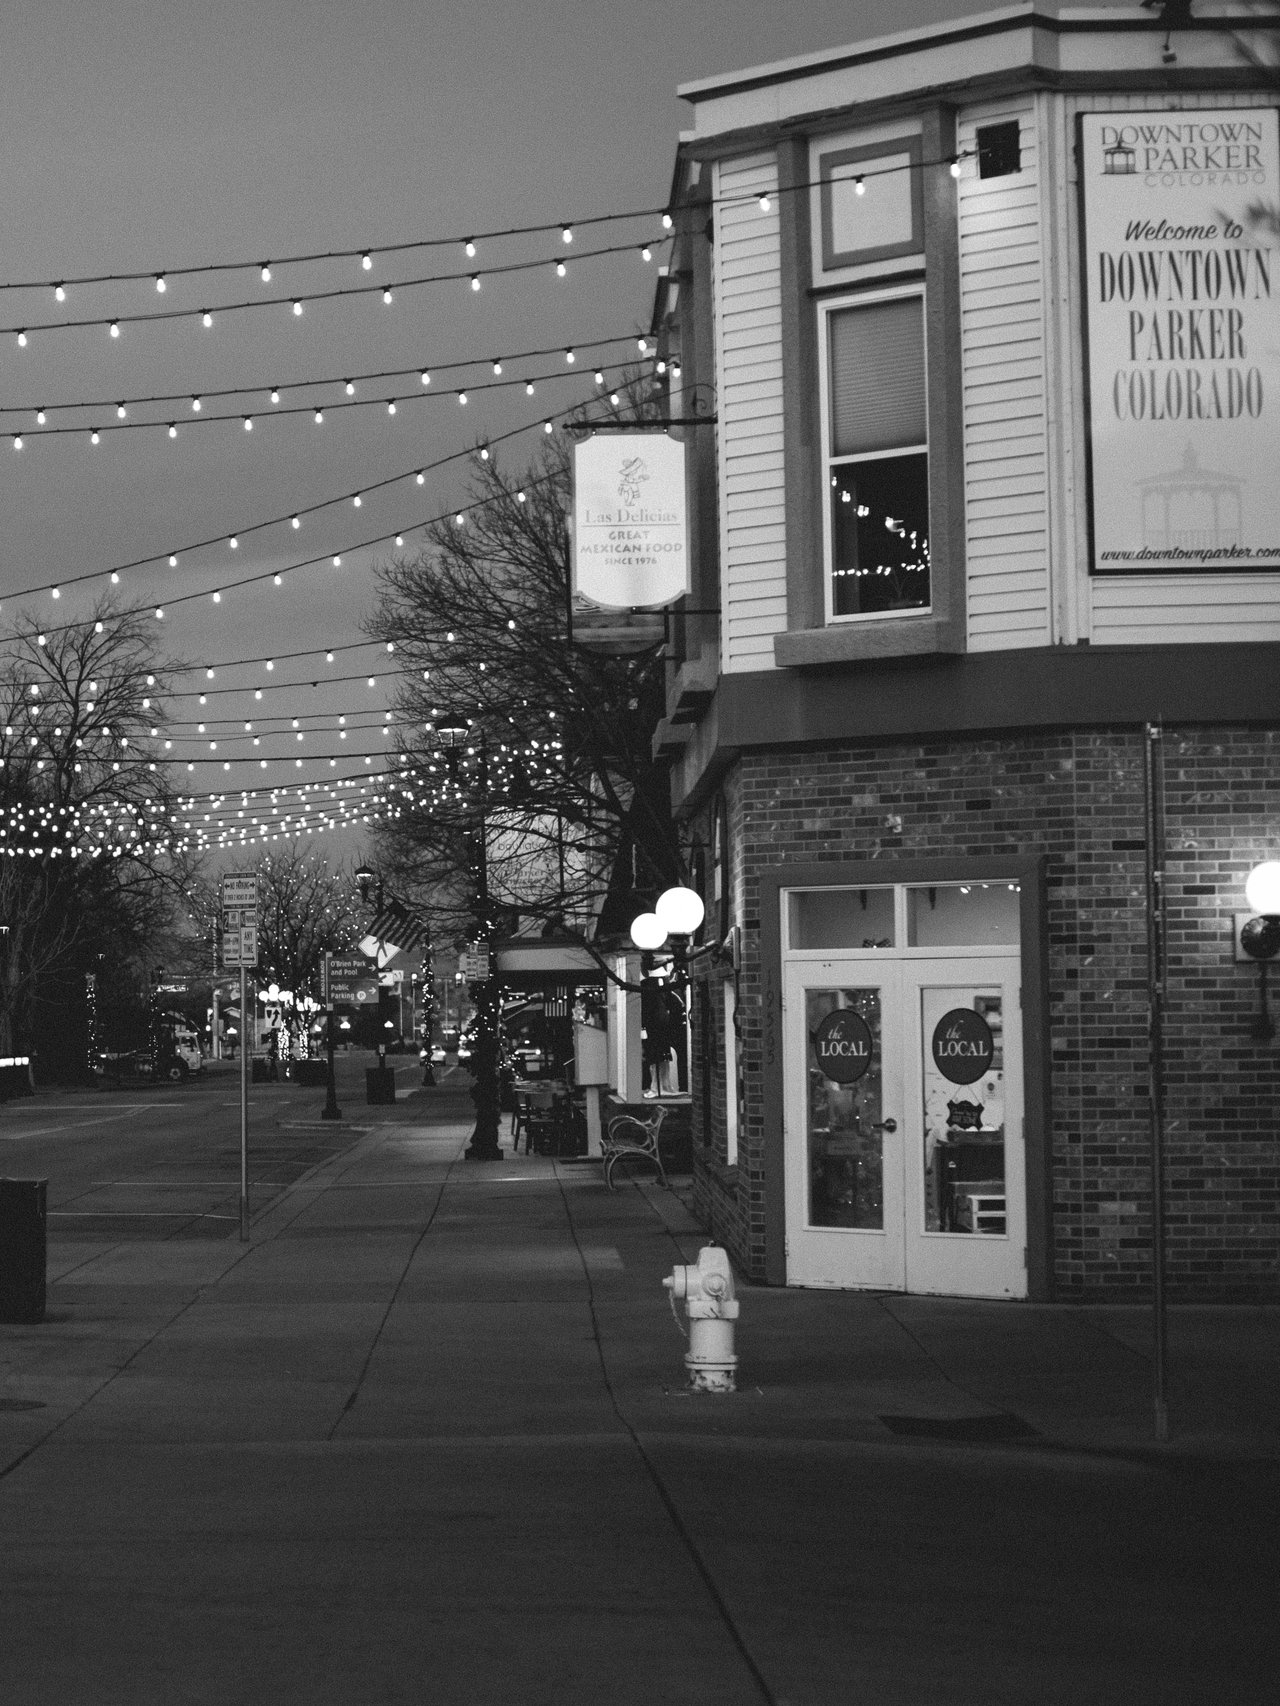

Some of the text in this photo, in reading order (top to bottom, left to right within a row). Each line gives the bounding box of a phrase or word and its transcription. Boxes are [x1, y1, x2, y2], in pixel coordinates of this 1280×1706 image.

[1101, 123, 1262, 145] DOWNTOWN
[1143, 144, 1264, 171] PARKER
[1144, 171, 1267, 187] COLORADO
[1124, 218, 1244, 241] Welcome to
[1099, 248, 1271, 302] DOWNTOWN
[1129, 308, 1247, 361] PARKER
[1113, 366, 1264, 421] COLORADO
[585, 508, 678, 523] Las Delicias
[609, 530, 651, 541] GREAT
[580, 542, 683, 554] MEXICAN FOOD
[1100, 543, 1280, 563] www.downtownparker.com
[604, 557, 634, 565] SINCE
[330, 968, 358, 976] and Pool
[330, 983, 350, 991] Public
[330, 992, 355, 1000] Parking
[828, 1021, 845, 1040] the
[945, 1020, 964, 1040] the
[820, 1040, 868, 1056] LOCAL
[938, 1040, 989, 1056] LOCAL
